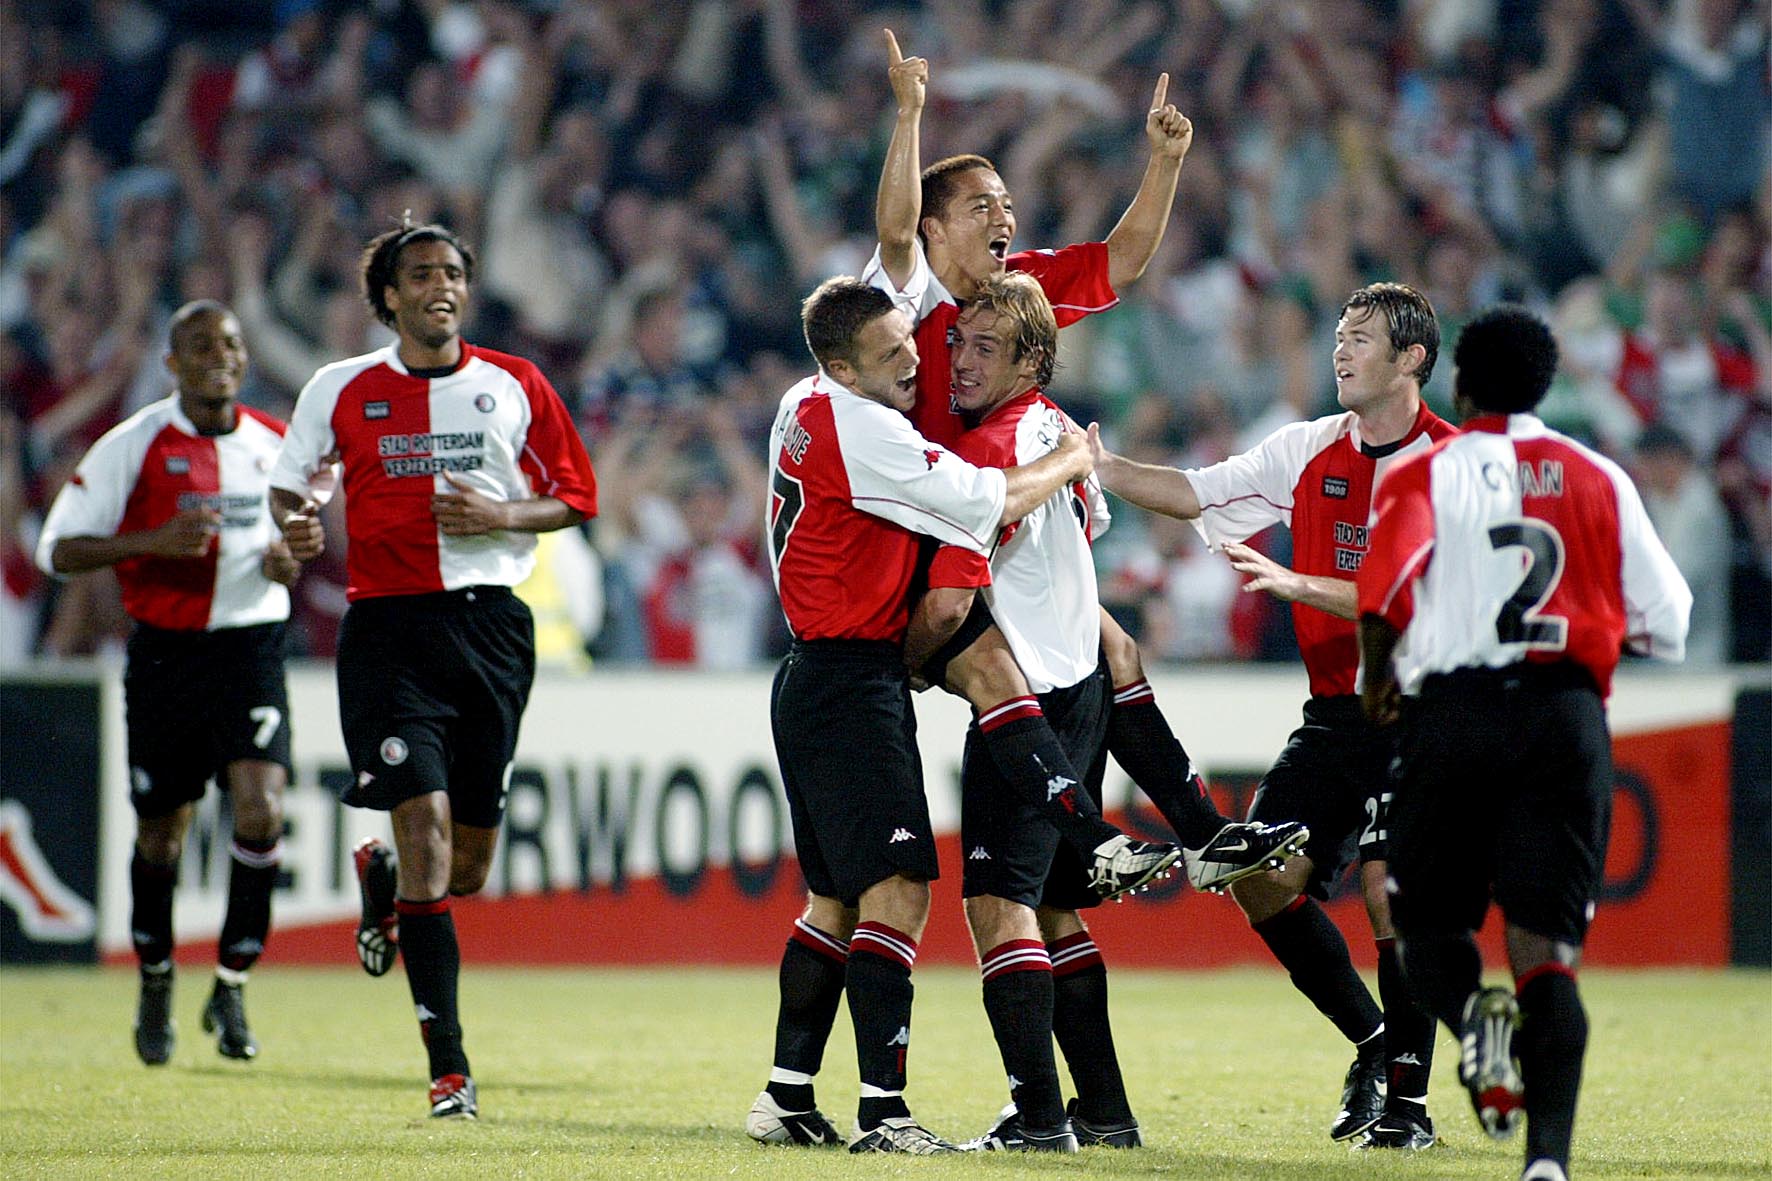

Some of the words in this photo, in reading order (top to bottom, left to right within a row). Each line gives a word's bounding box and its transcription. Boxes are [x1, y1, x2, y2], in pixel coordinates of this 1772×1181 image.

[379, 434, 410, 456] STAD
[411, 431, 484, 453] ROTTERDAM
[1334, 521, 1355, 546] STAD
[1487, 518, 1568, 652] 2
[250, 706, 281, 749] 7
